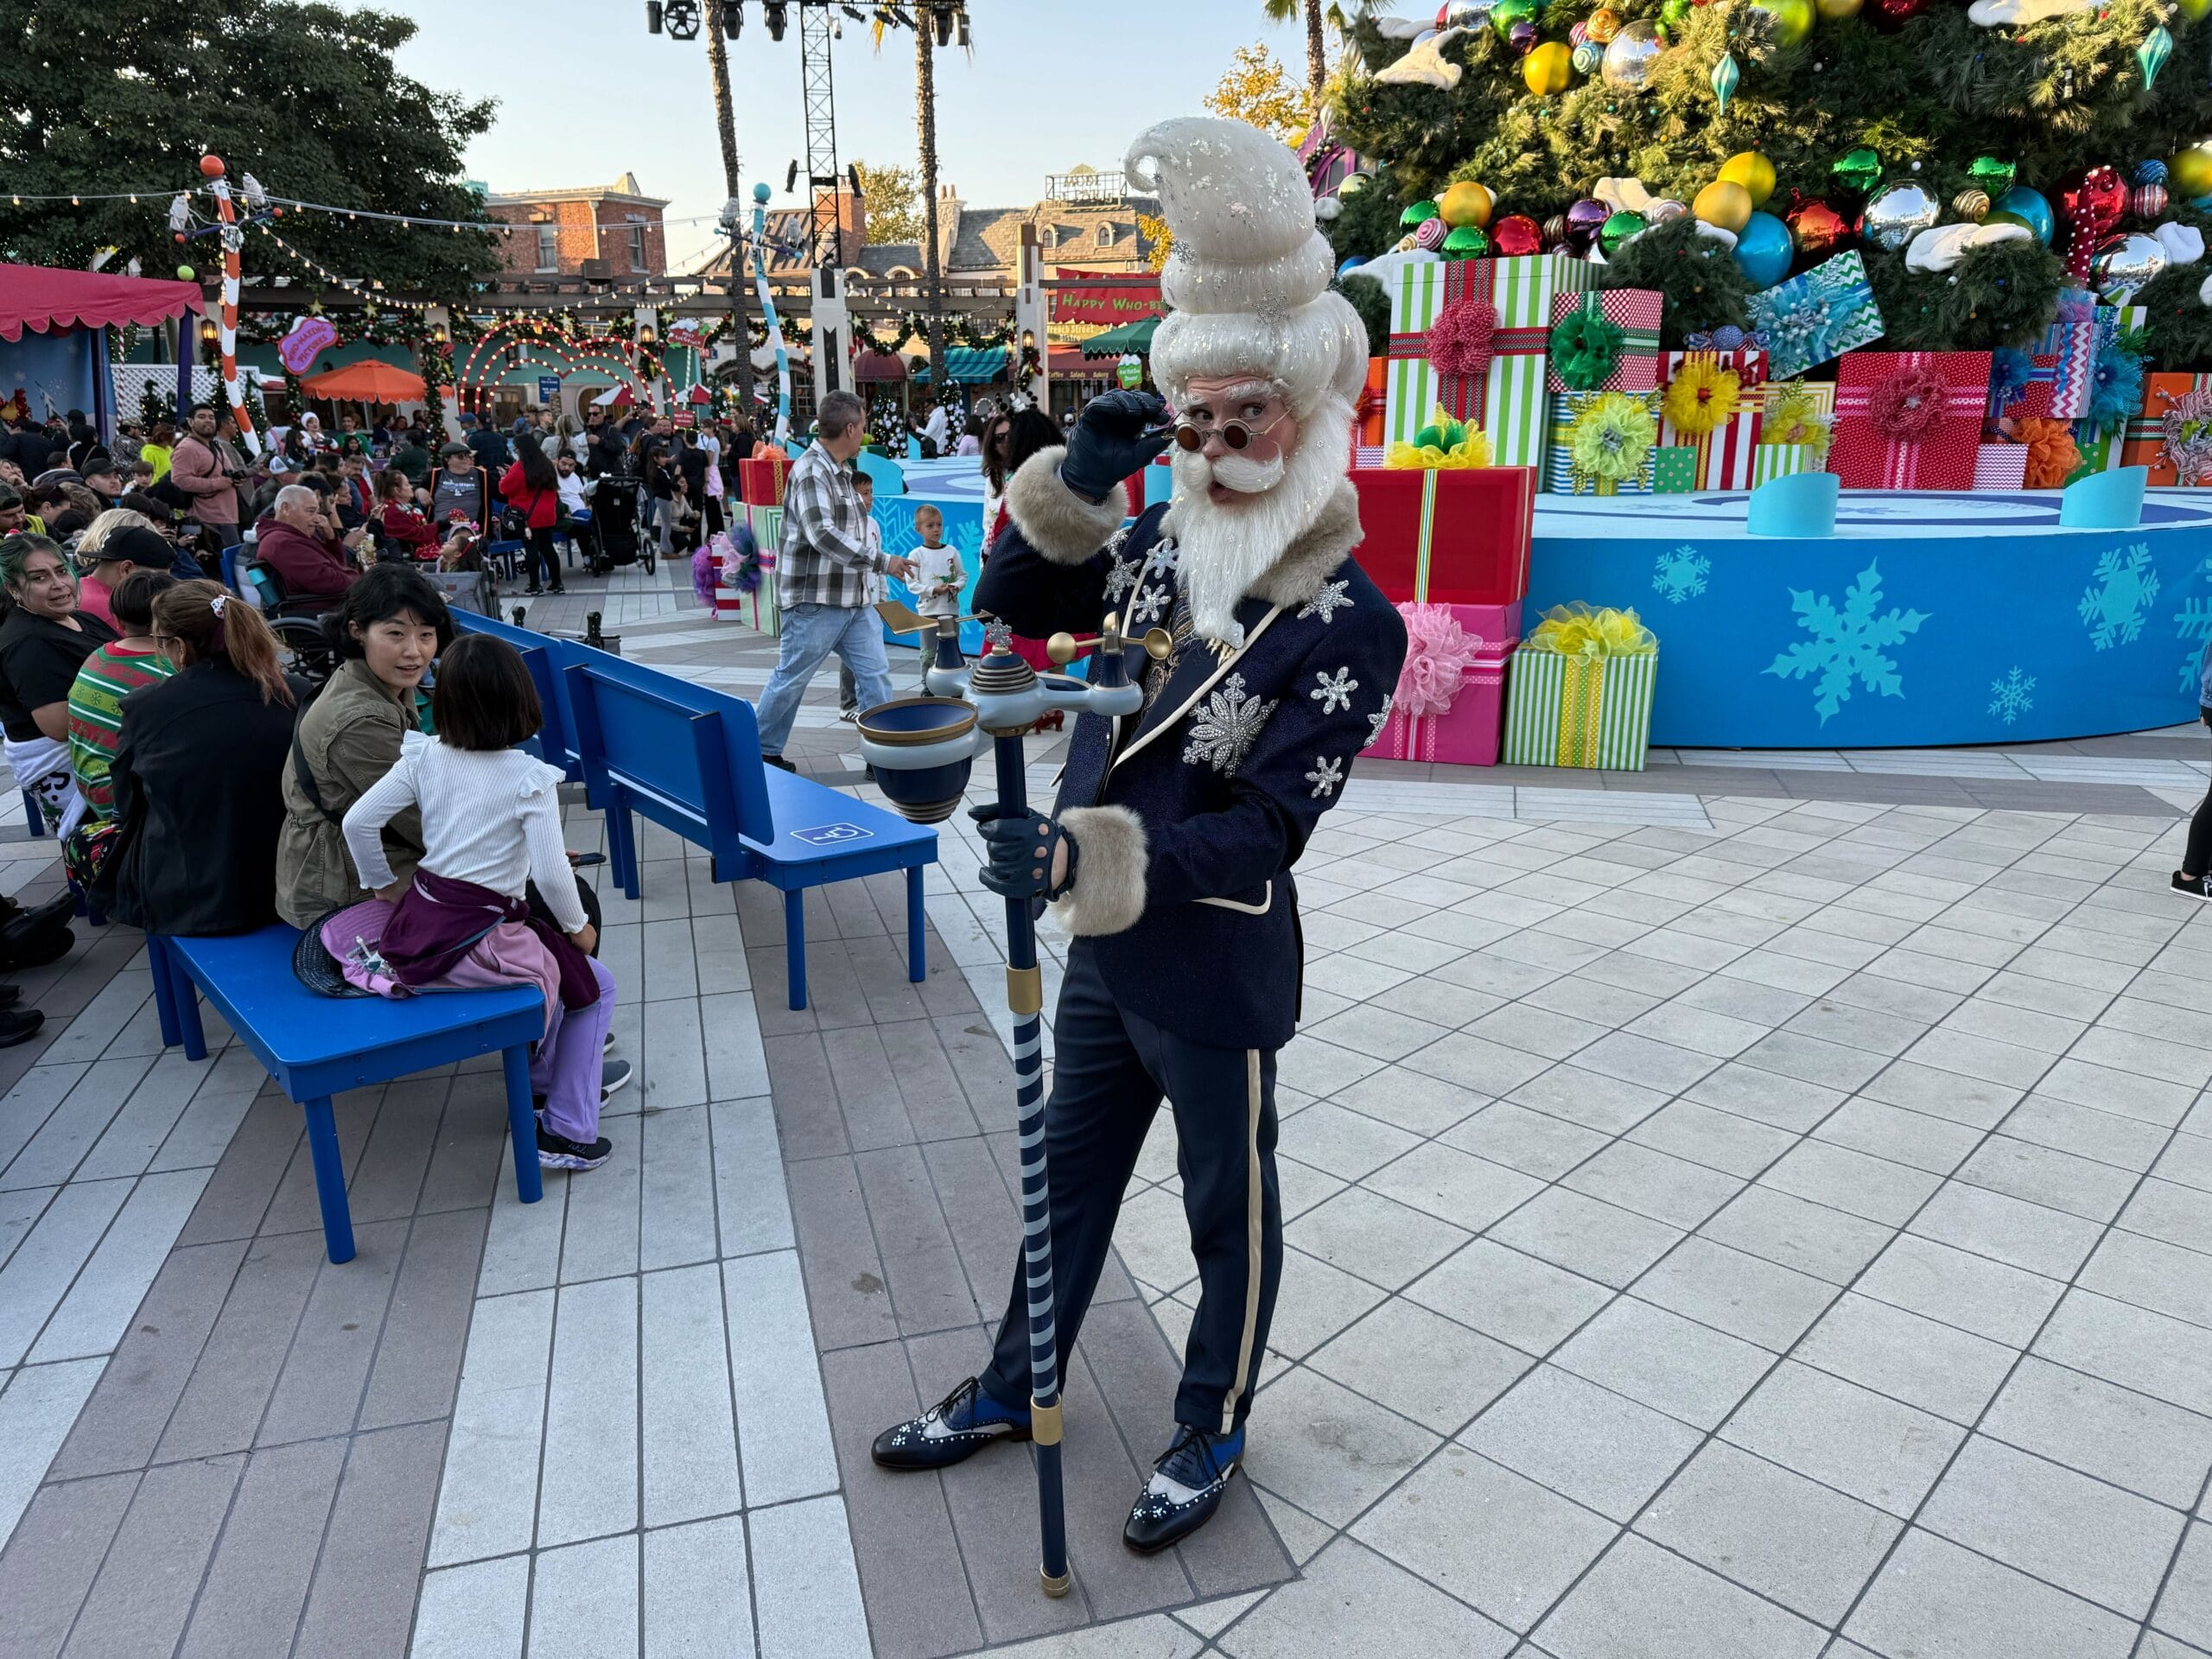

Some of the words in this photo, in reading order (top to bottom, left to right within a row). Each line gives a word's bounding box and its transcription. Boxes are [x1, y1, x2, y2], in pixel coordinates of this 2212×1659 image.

[1062, 294, 1105, 309] HAPPY
[1071, 324, 1094, 334] Street
[1059, 334, 1082, 342] Bistro
[297, 334, 327, 363] PICTURES
